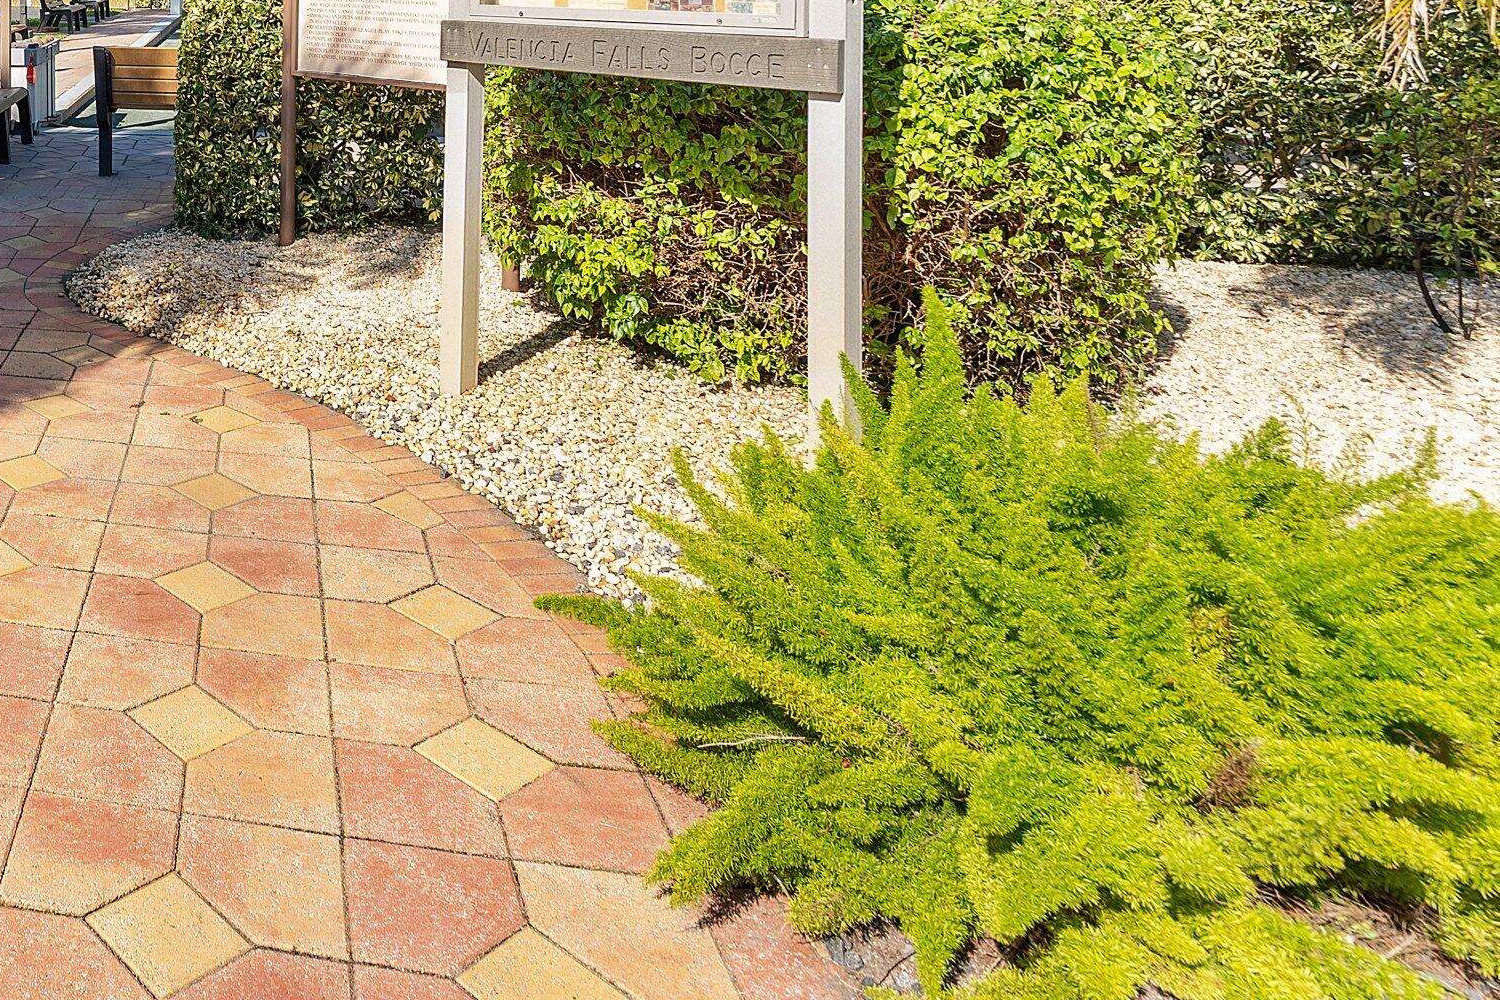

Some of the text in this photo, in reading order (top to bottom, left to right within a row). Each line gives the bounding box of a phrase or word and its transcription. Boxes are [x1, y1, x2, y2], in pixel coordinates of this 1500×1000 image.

[468, 30, 786, 79] VALENCIA FALLS BOCCE
